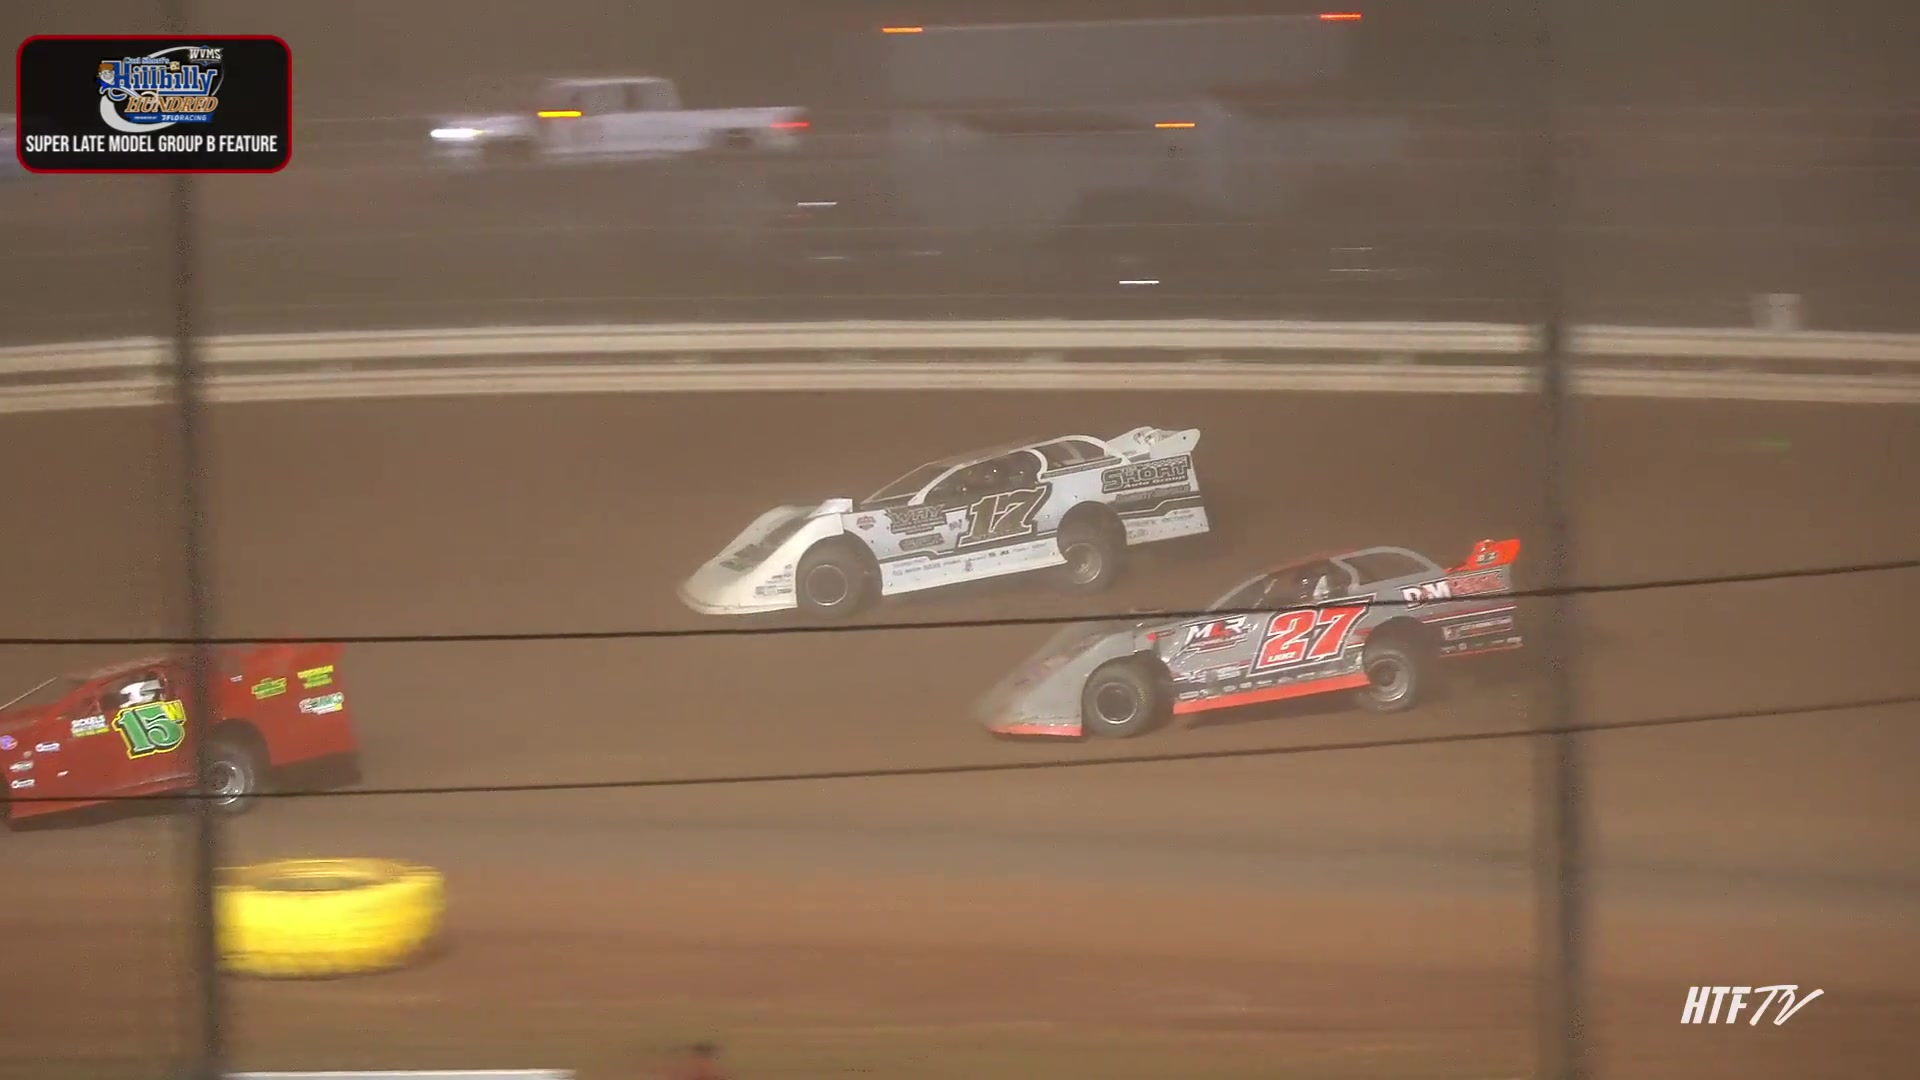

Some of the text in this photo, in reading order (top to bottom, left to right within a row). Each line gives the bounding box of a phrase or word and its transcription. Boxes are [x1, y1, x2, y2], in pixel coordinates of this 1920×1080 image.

[1102, 456, 1189, 493] SHORT
[958, 485, 1047, 548] 17
[1256, 593, 1377, 670] 27
[115, 702, 185, 756] 15
